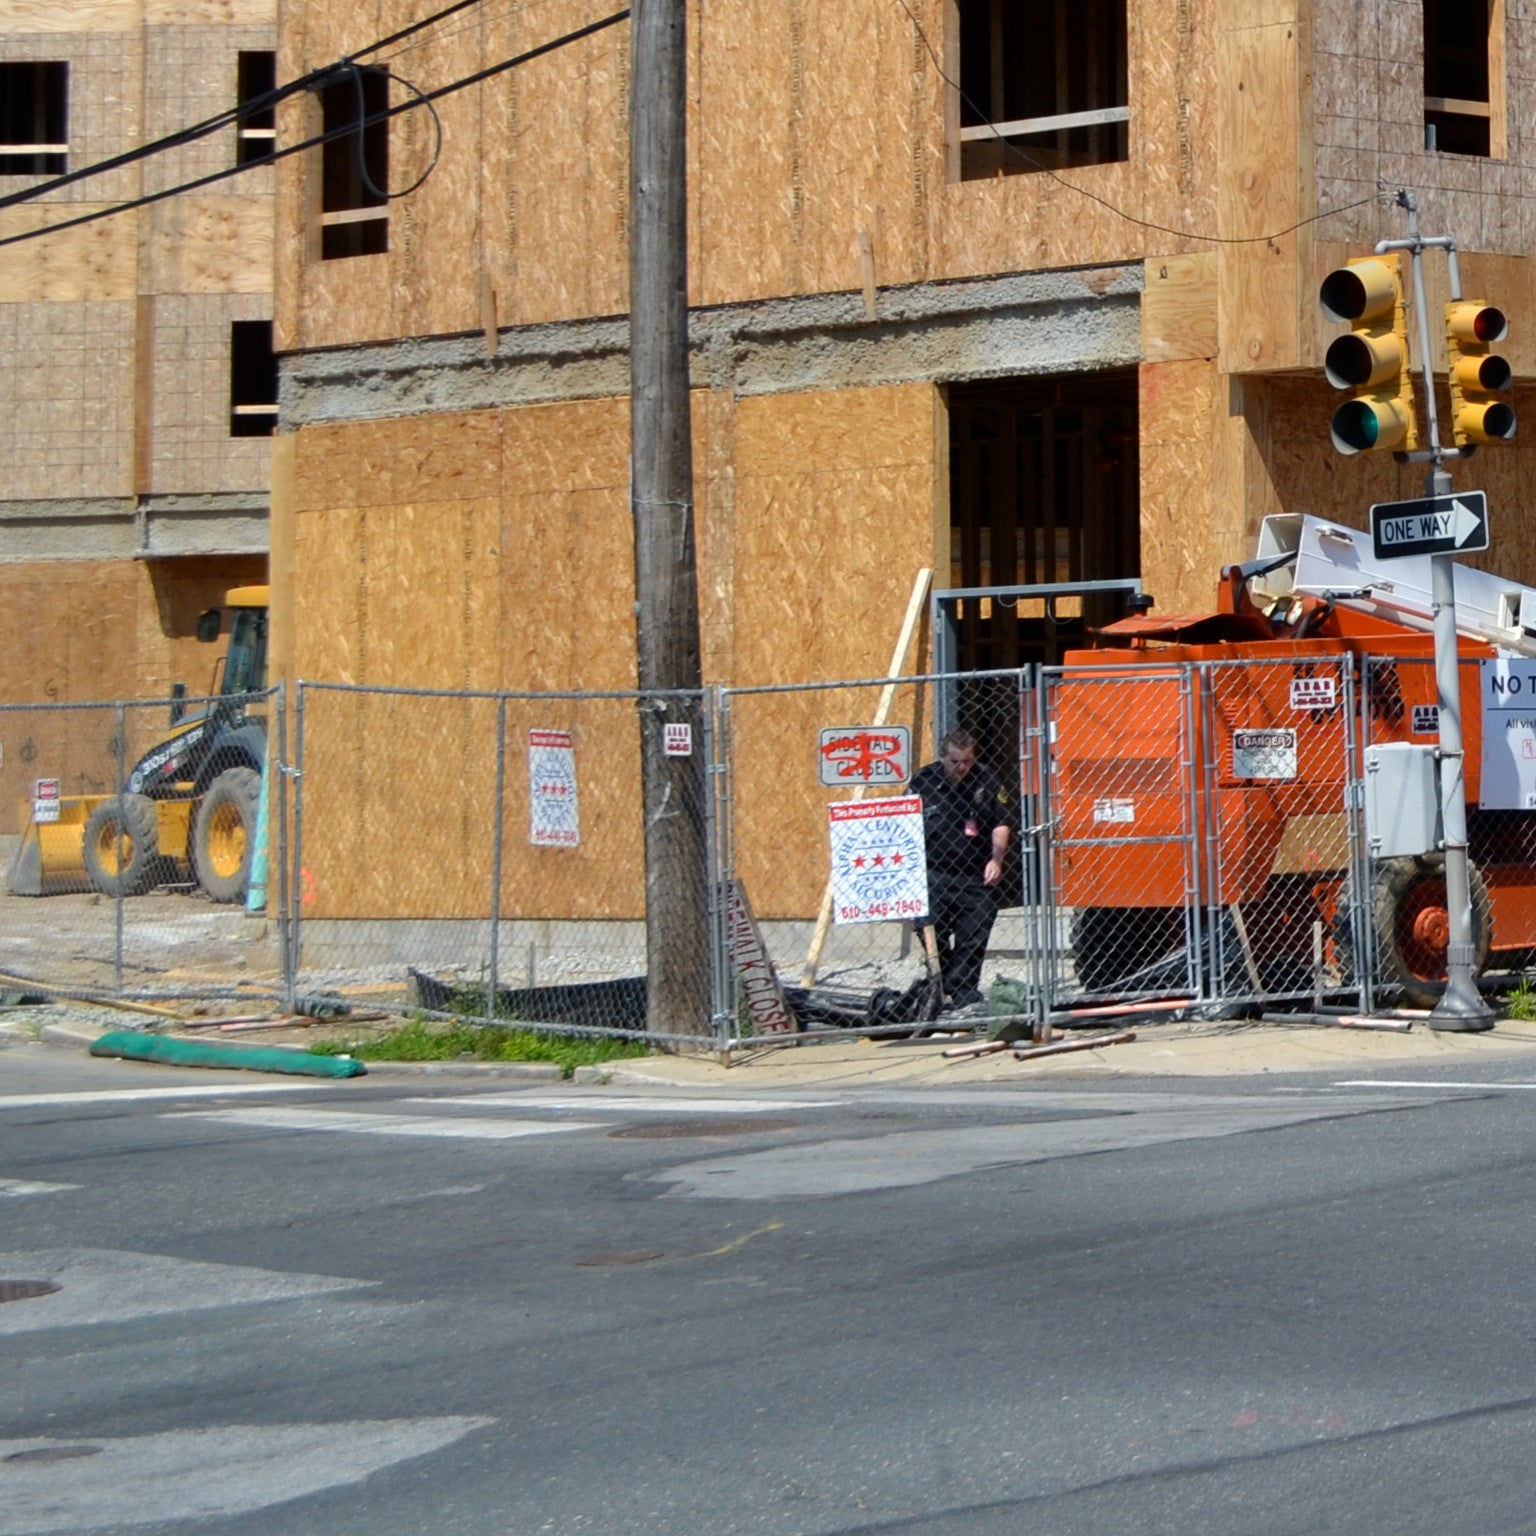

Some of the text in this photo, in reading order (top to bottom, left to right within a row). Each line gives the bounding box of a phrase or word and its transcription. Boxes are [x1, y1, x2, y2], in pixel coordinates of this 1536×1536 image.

[1385, 514, 1451, 541] ONE WAY
[1491, 675, 1522, 694] NO
[1506, 718, 1519, 729] All
[829, 734, 901, 753] SIDEALK
[1243, 735, 1287, 746] DANGER
[850, 876, 910, 900] SECURITY
